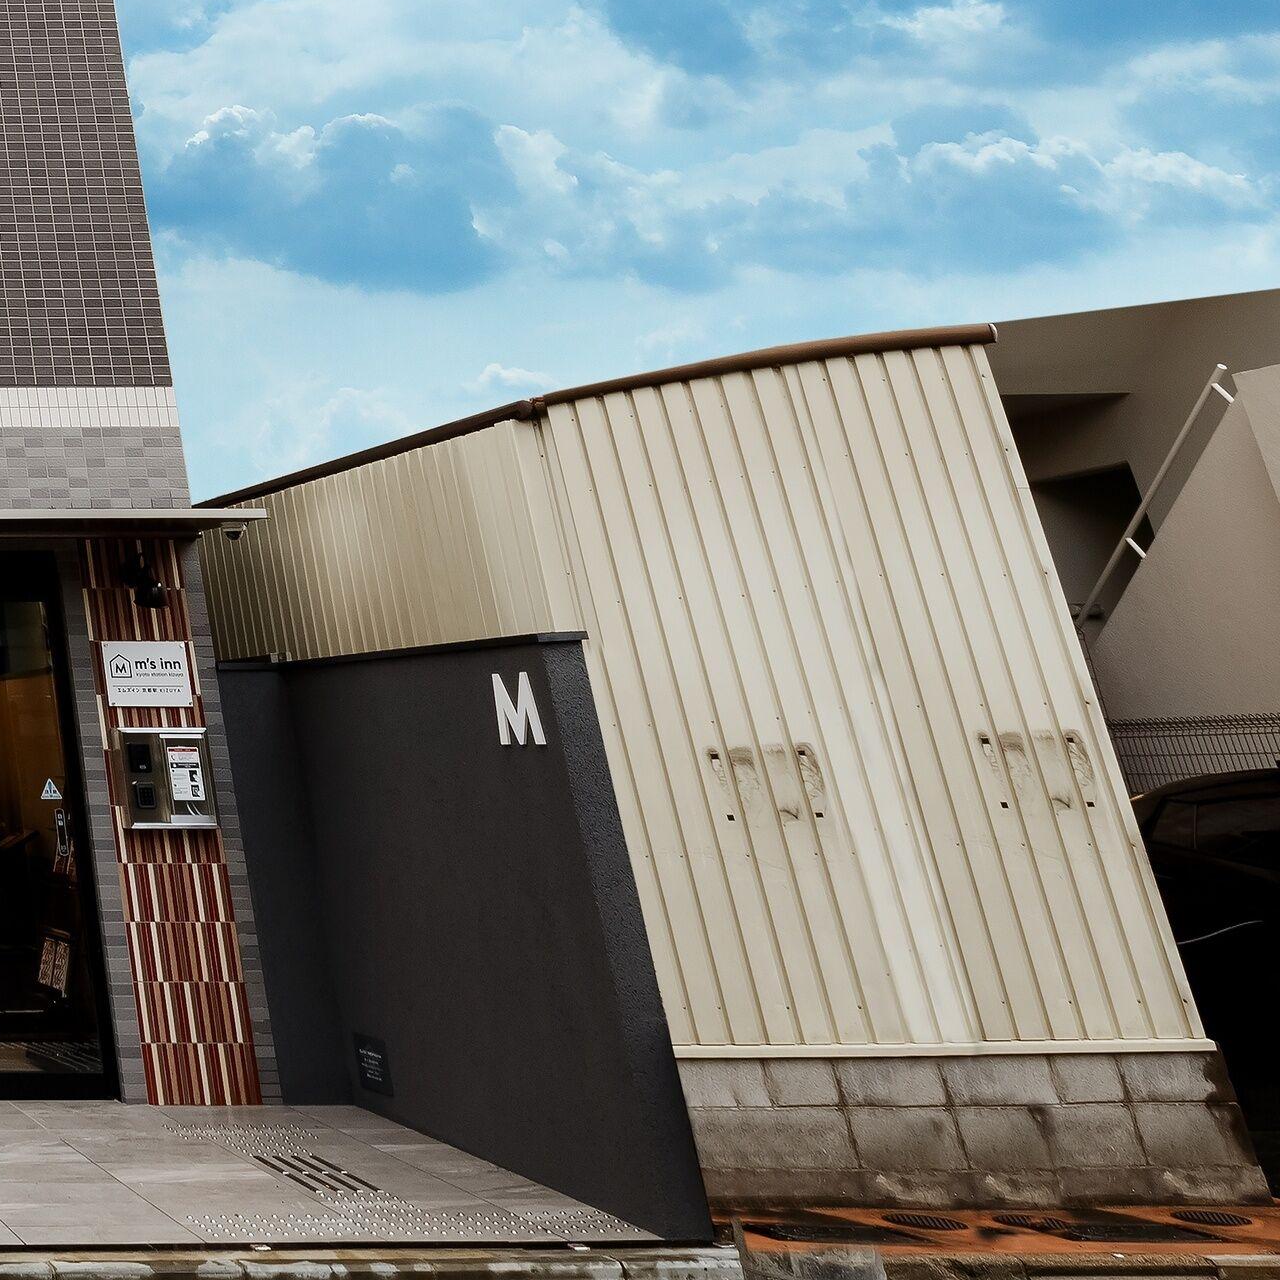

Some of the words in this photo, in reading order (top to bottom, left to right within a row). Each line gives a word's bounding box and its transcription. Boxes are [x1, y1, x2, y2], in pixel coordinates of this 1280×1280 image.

[115, 662, 127, 674] M
[134, 657, 157, 670] m's
[160, 657, 182, 670] inn
[491, 671, 547, 746] M
